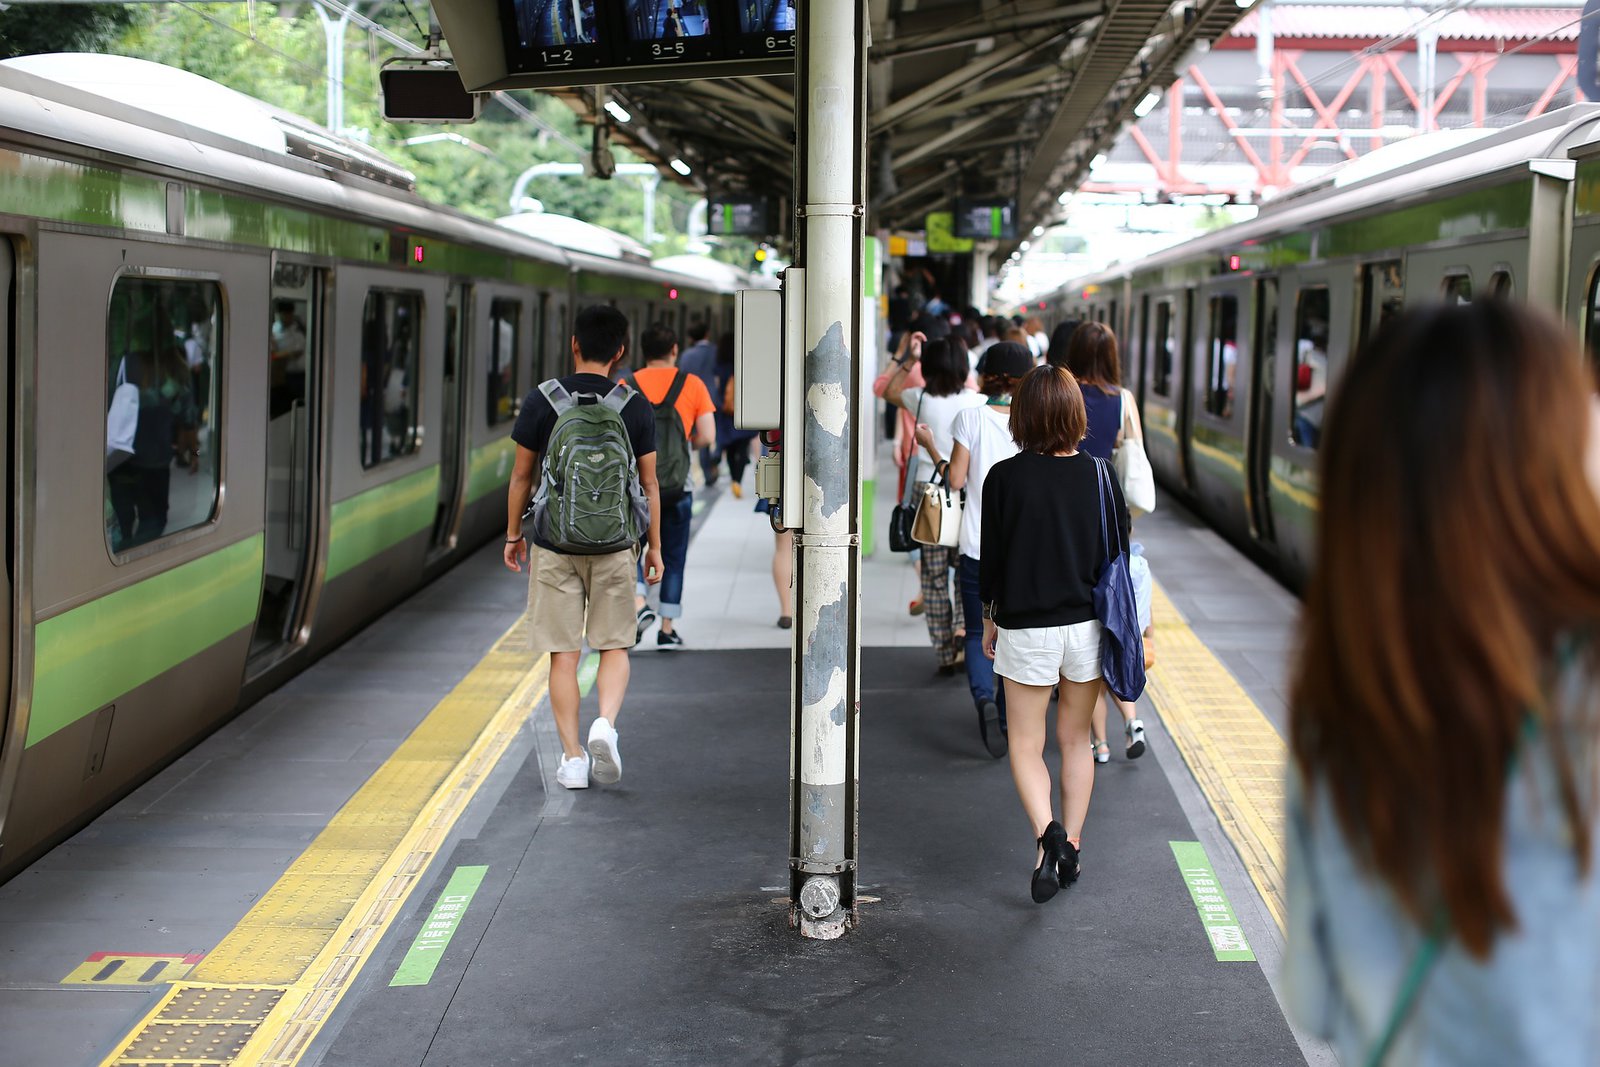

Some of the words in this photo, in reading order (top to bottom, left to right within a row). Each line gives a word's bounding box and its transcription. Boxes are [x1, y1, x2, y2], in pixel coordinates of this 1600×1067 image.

[652, 42, 685, 55] 3-5
[541, 49, 573, 63] 1-2
[416, 895, 469, 950] 11号車乗車口
